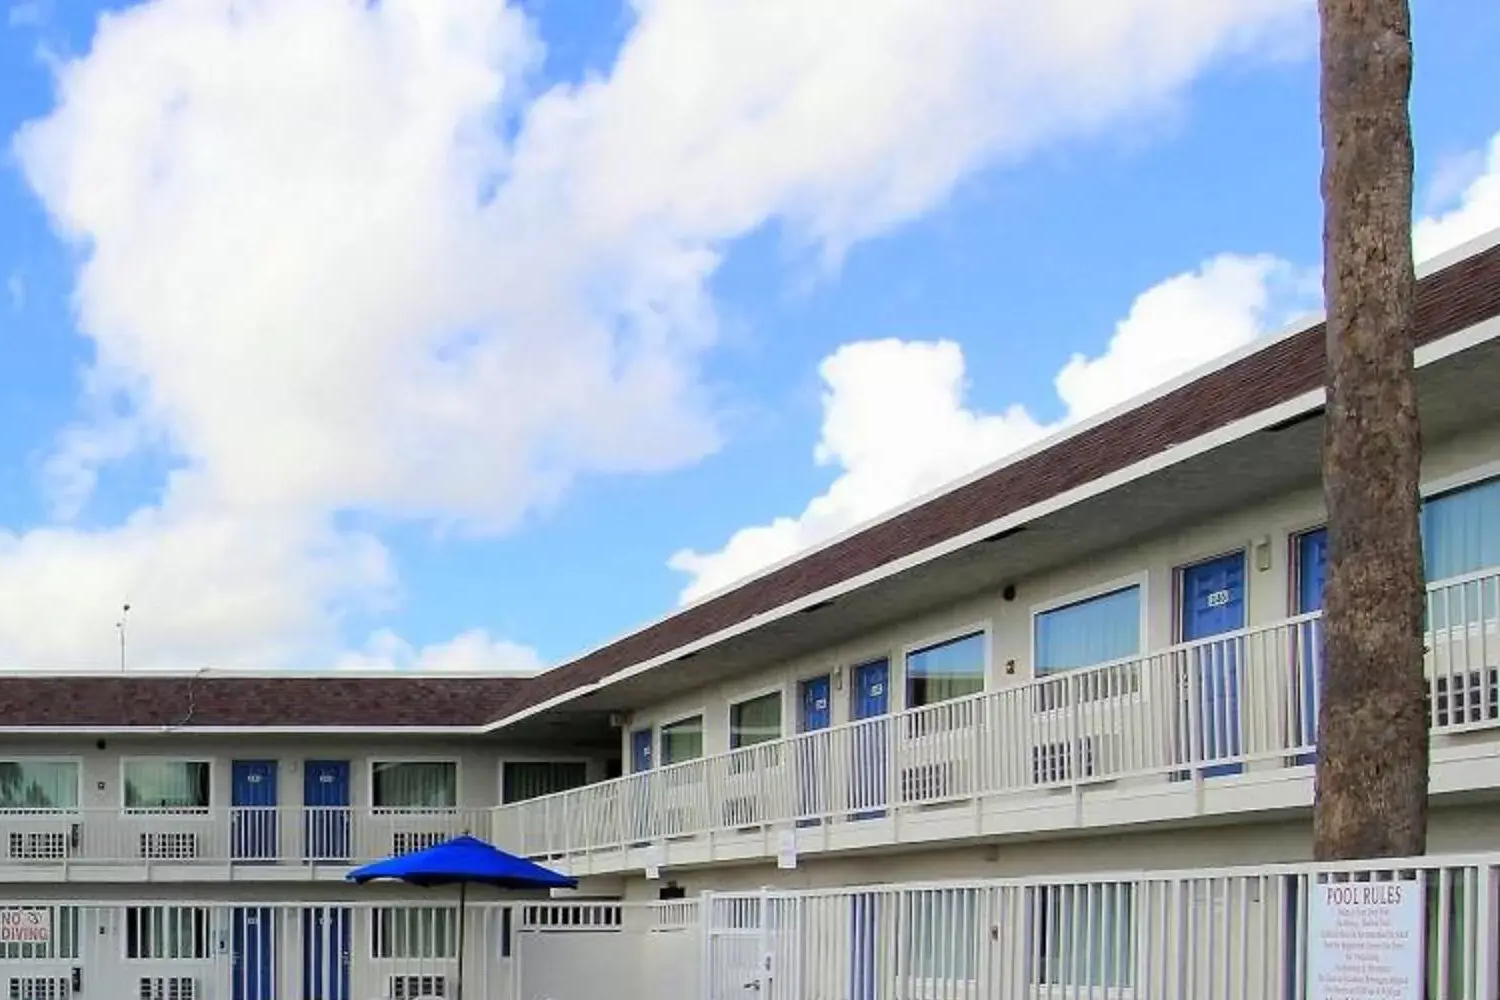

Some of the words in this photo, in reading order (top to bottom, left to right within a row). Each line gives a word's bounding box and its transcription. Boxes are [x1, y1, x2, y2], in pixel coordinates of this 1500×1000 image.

[1327, 886, 1360, 905] POOL
[1363, 885, 1401, 904] RULES
[2, 910, 21, 925] NO
[2, 927, 47, 940] DIVING
